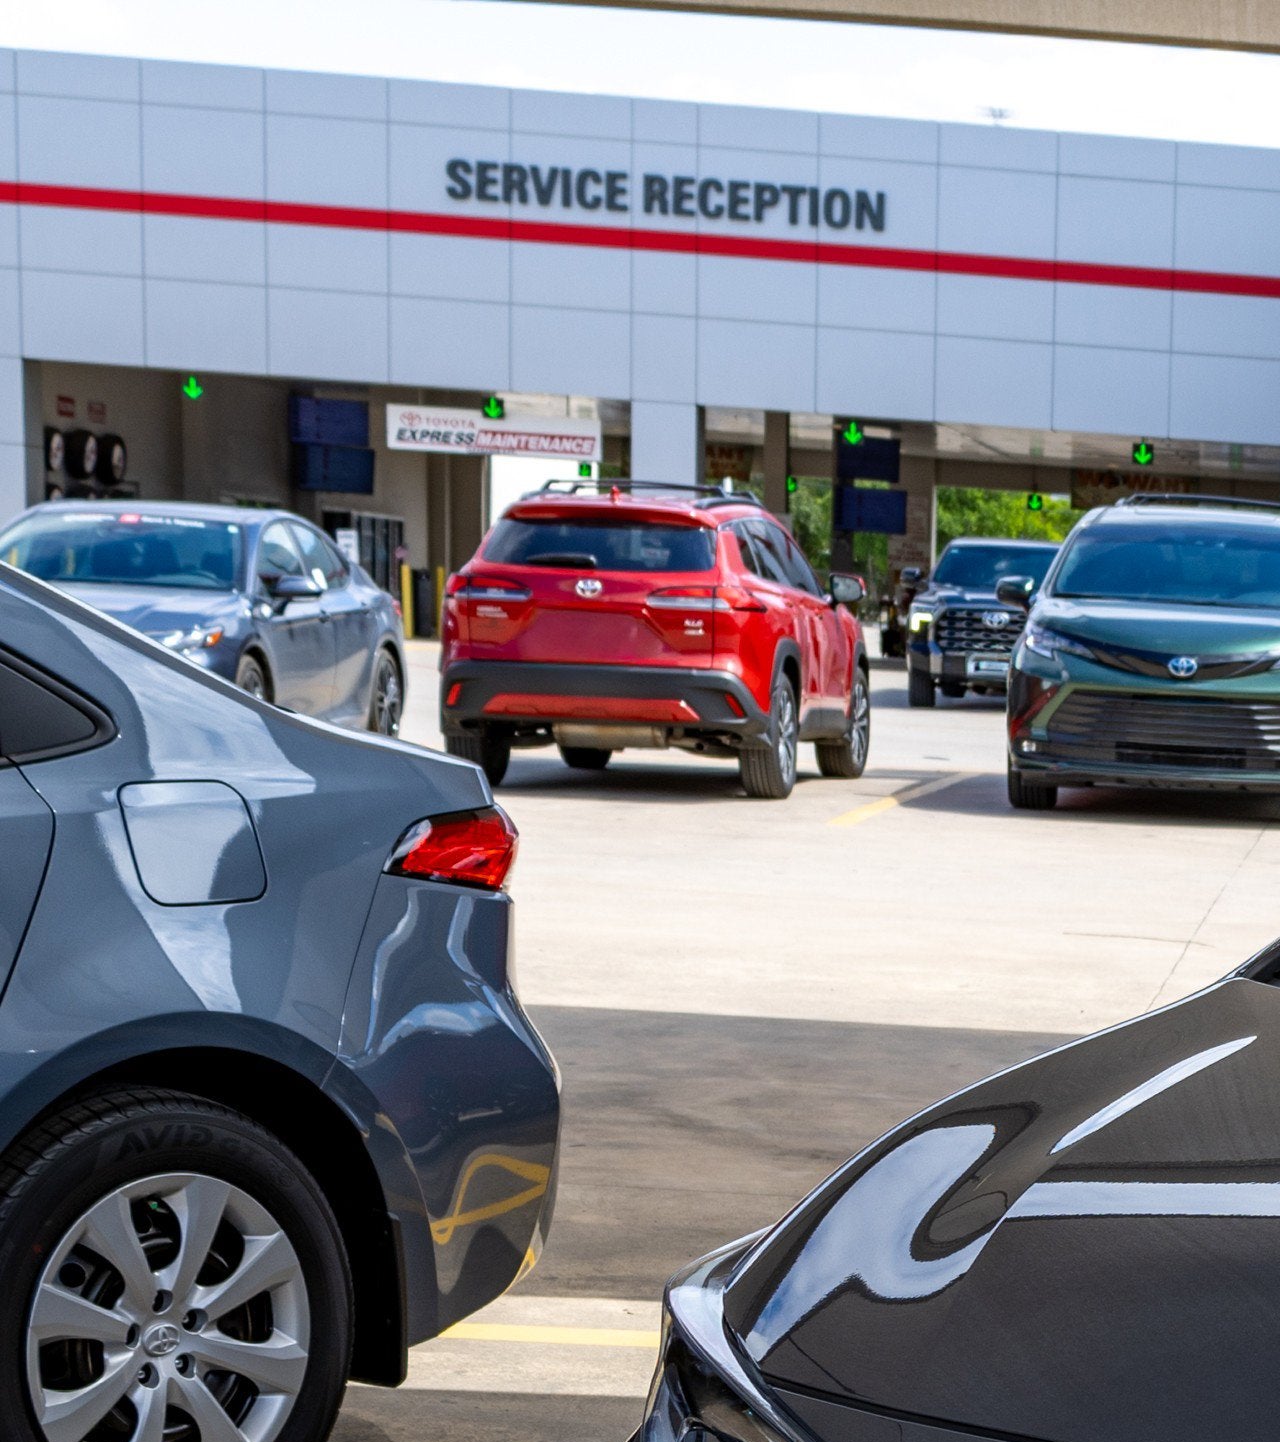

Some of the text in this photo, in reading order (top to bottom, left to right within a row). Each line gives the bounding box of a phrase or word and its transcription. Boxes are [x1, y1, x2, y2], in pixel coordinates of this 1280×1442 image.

[445, 159, 887, 232] SERVICE RECEPTION
[425, 416, 477, 429] TOYOTA
[396, 427, 595, 454] EXPRESS MAINTENANCE
